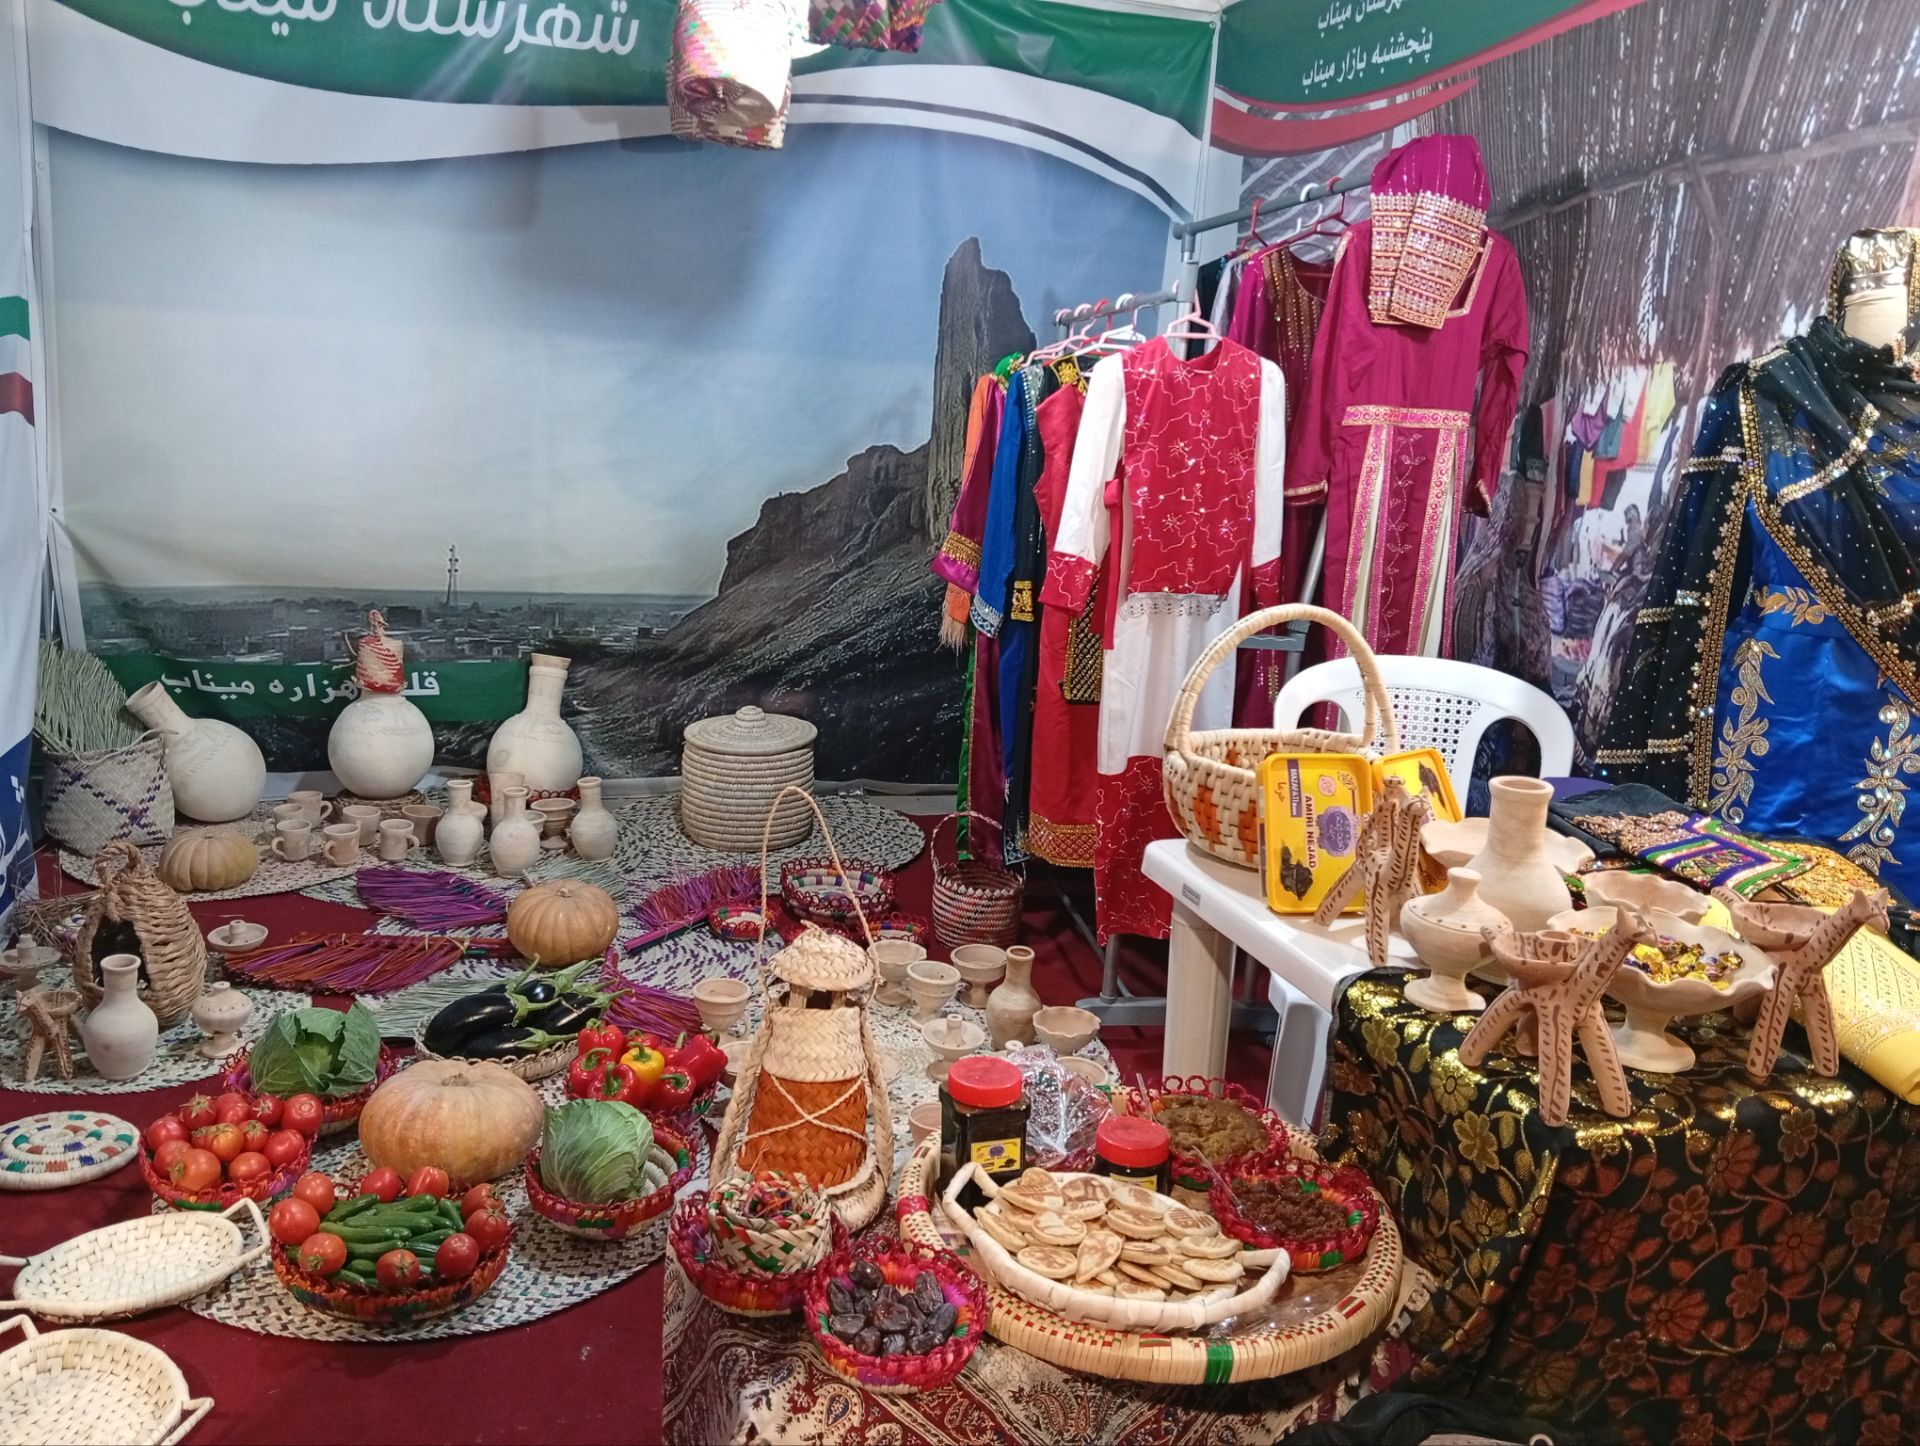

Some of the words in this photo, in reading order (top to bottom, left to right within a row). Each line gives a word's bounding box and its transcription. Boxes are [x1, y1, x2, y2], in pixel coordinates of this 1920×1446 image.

[1318, 2, 1352, 38] میناب
[1337, 45, 1367, 83] بازار
[1371, 27, 1433, 74] پنجشنبه
[1302, 59, 1335, 95] میناب
[161, 669, 255, 700] میناب
[400, 670, 441, 696] قل
[1304, 795, 1315, 828] AMIRI
[1306, 831, 1317, 869] NEJAD
